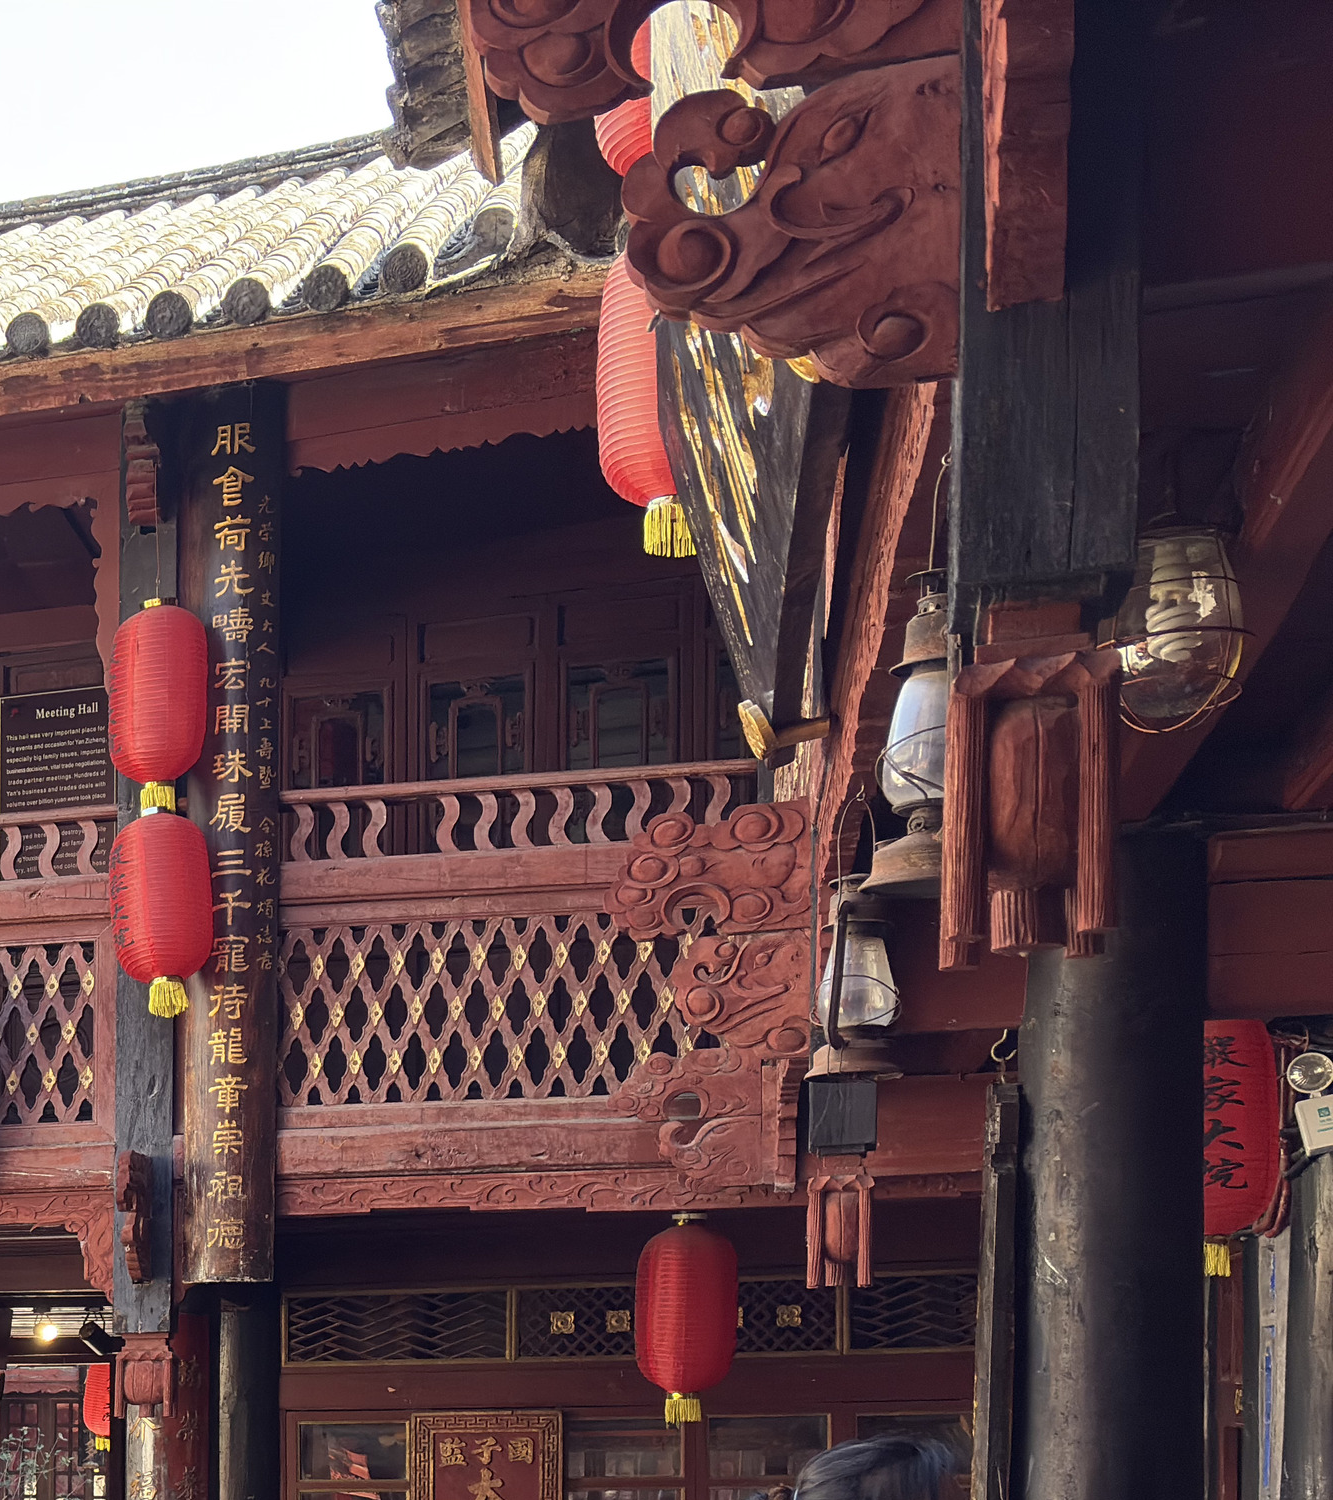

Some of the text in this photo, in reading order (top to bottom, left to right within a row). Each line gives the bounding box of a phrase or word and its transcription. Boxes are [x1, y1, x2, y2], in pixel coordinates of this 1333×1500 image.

[35, 701, 99, 720] Meeting Hall
[54, 728, 81, 737] important
[81, 726, 97, 734] place
[44, 740, 68, 749] occasion
[6, 755, 33, 764] especially
[33, 754, 42, 762] big
[42, 753, 59, 761] family
[80, 748, 106, 757] important
[6, 767, 26, 775] business
[24, 777, 45, 785] partner
[74, 771, 100, 779] Hundreds
[22, 787, 47, 796] business
[59, 784, 77, 792] trades
[78, 782, 94, 790] deals
[6, 800, 26, 809] volume
[38, 797, 54, 805] billion
[54, 796, 67, 804] yuan
[92, 792, 106, 800] place
